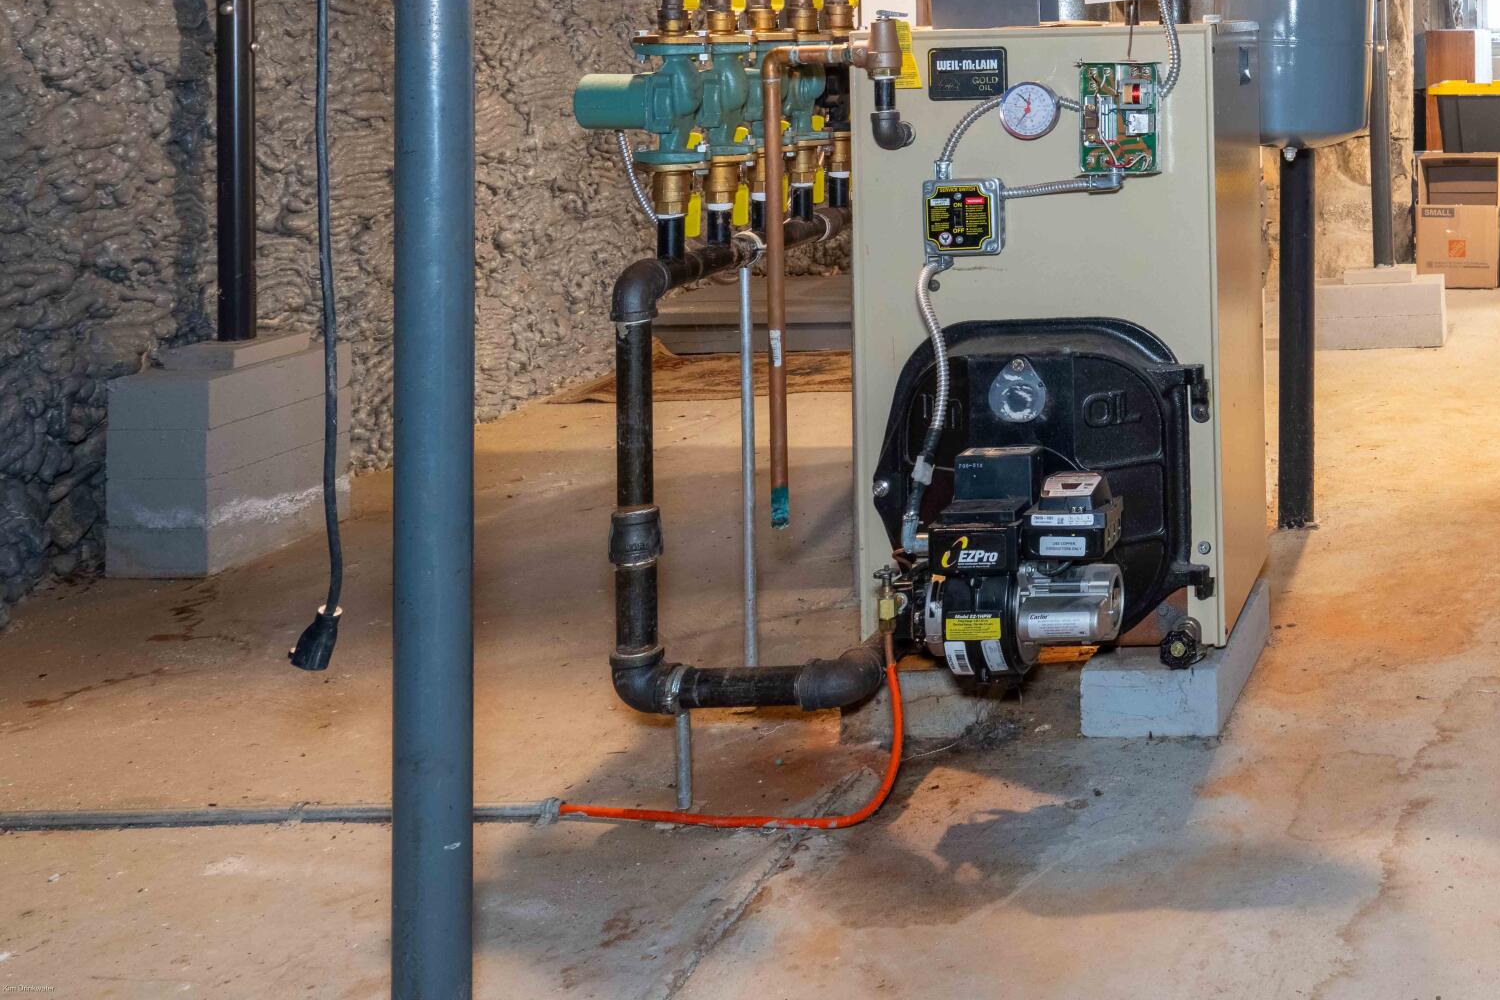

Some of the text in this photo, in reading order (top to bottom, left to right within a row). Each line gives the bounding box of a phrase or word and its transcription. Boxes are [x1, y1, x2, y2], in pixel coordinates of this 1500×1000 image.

[936, 59, 998, 71] WEIL-McLAIN
[972, 76, 999, 85] GOLD
[1082, 391, 1142, 428] OIL
[958, 550, 999, 563] EZPro
